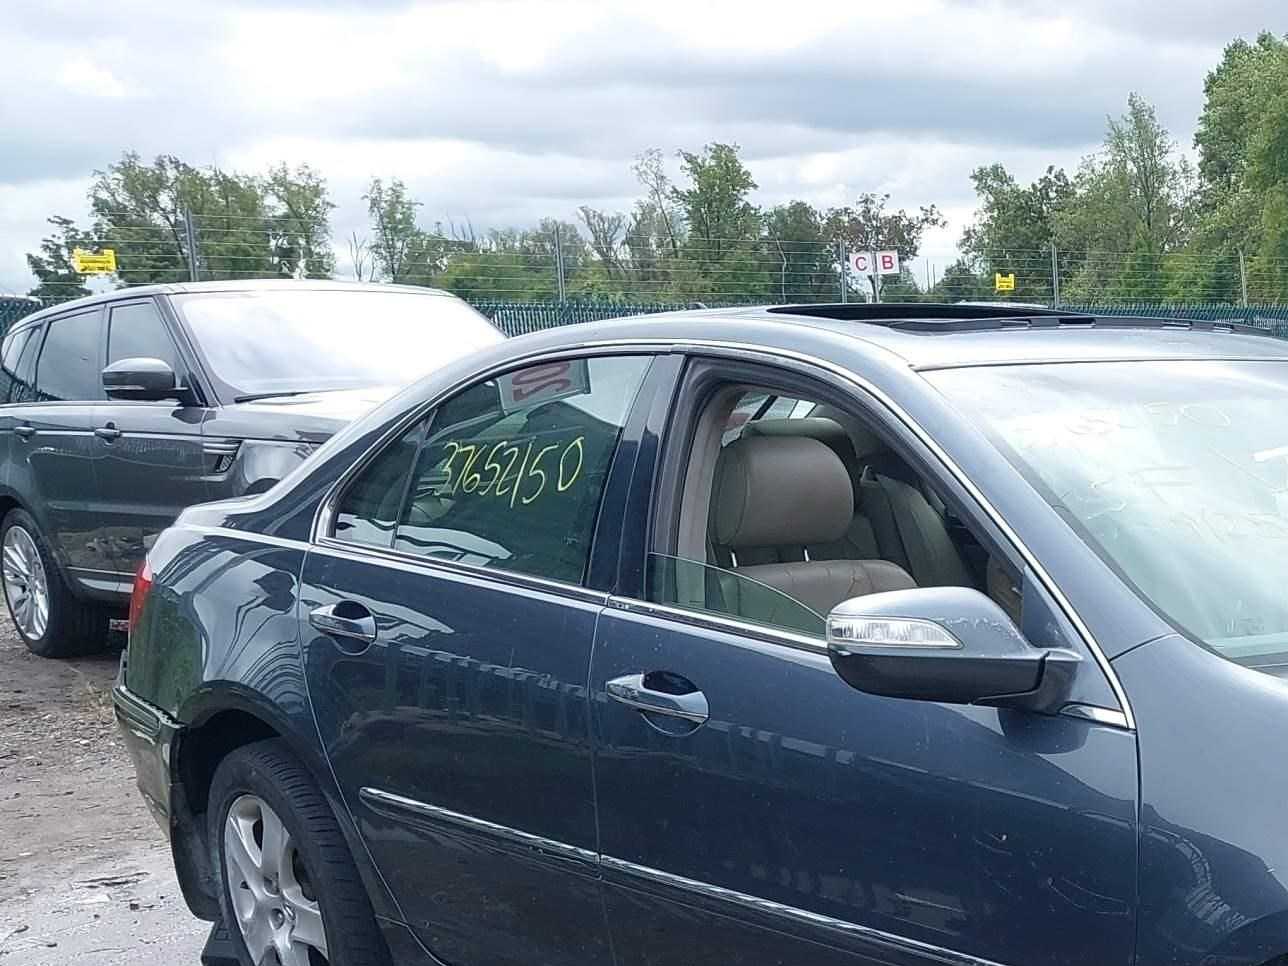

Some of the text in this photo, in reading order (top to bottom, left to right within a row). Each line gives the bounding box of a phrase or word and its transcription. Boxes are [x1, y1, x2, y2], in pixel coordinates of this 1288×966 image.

[855, 256, 868, 271] C
[881, 255, 894, 270] B
[433, 436, 585, 509] 37652150
